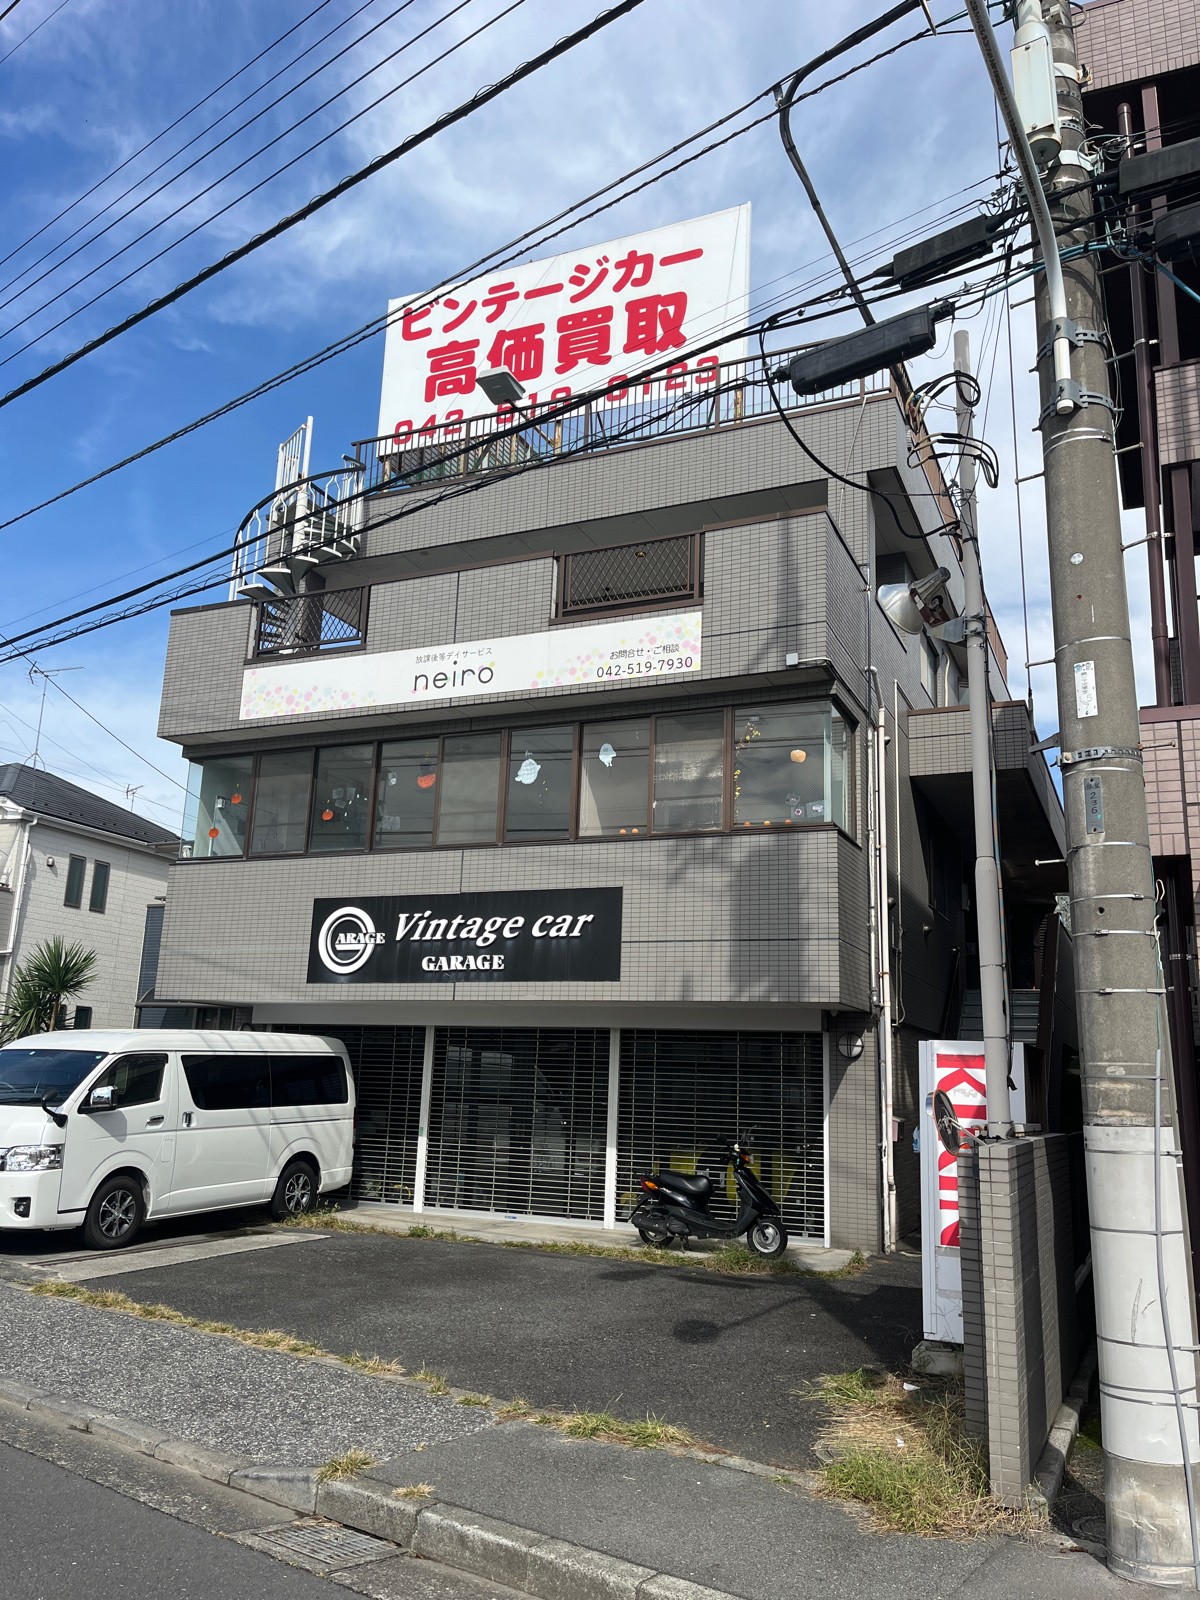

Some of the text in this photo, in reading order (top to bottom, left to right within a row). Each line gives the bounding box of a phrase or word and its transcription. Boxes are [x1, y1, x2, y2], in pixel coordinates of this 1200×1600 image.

[402, 248, 704, 341] ビンテージカー
[424, 291, 688, 402] 高価買取
[415, 647, 493, 664] 放課後等デイサービス
[610, 643, 680, 660] お問合せ・ご相談
[414, 660, 494, 691] neiro
[597, 656, 693, 678] 042-519-7930
[396, 910, 595, 947] Vintage car
[421, 954, 505, 971] GARAGE
